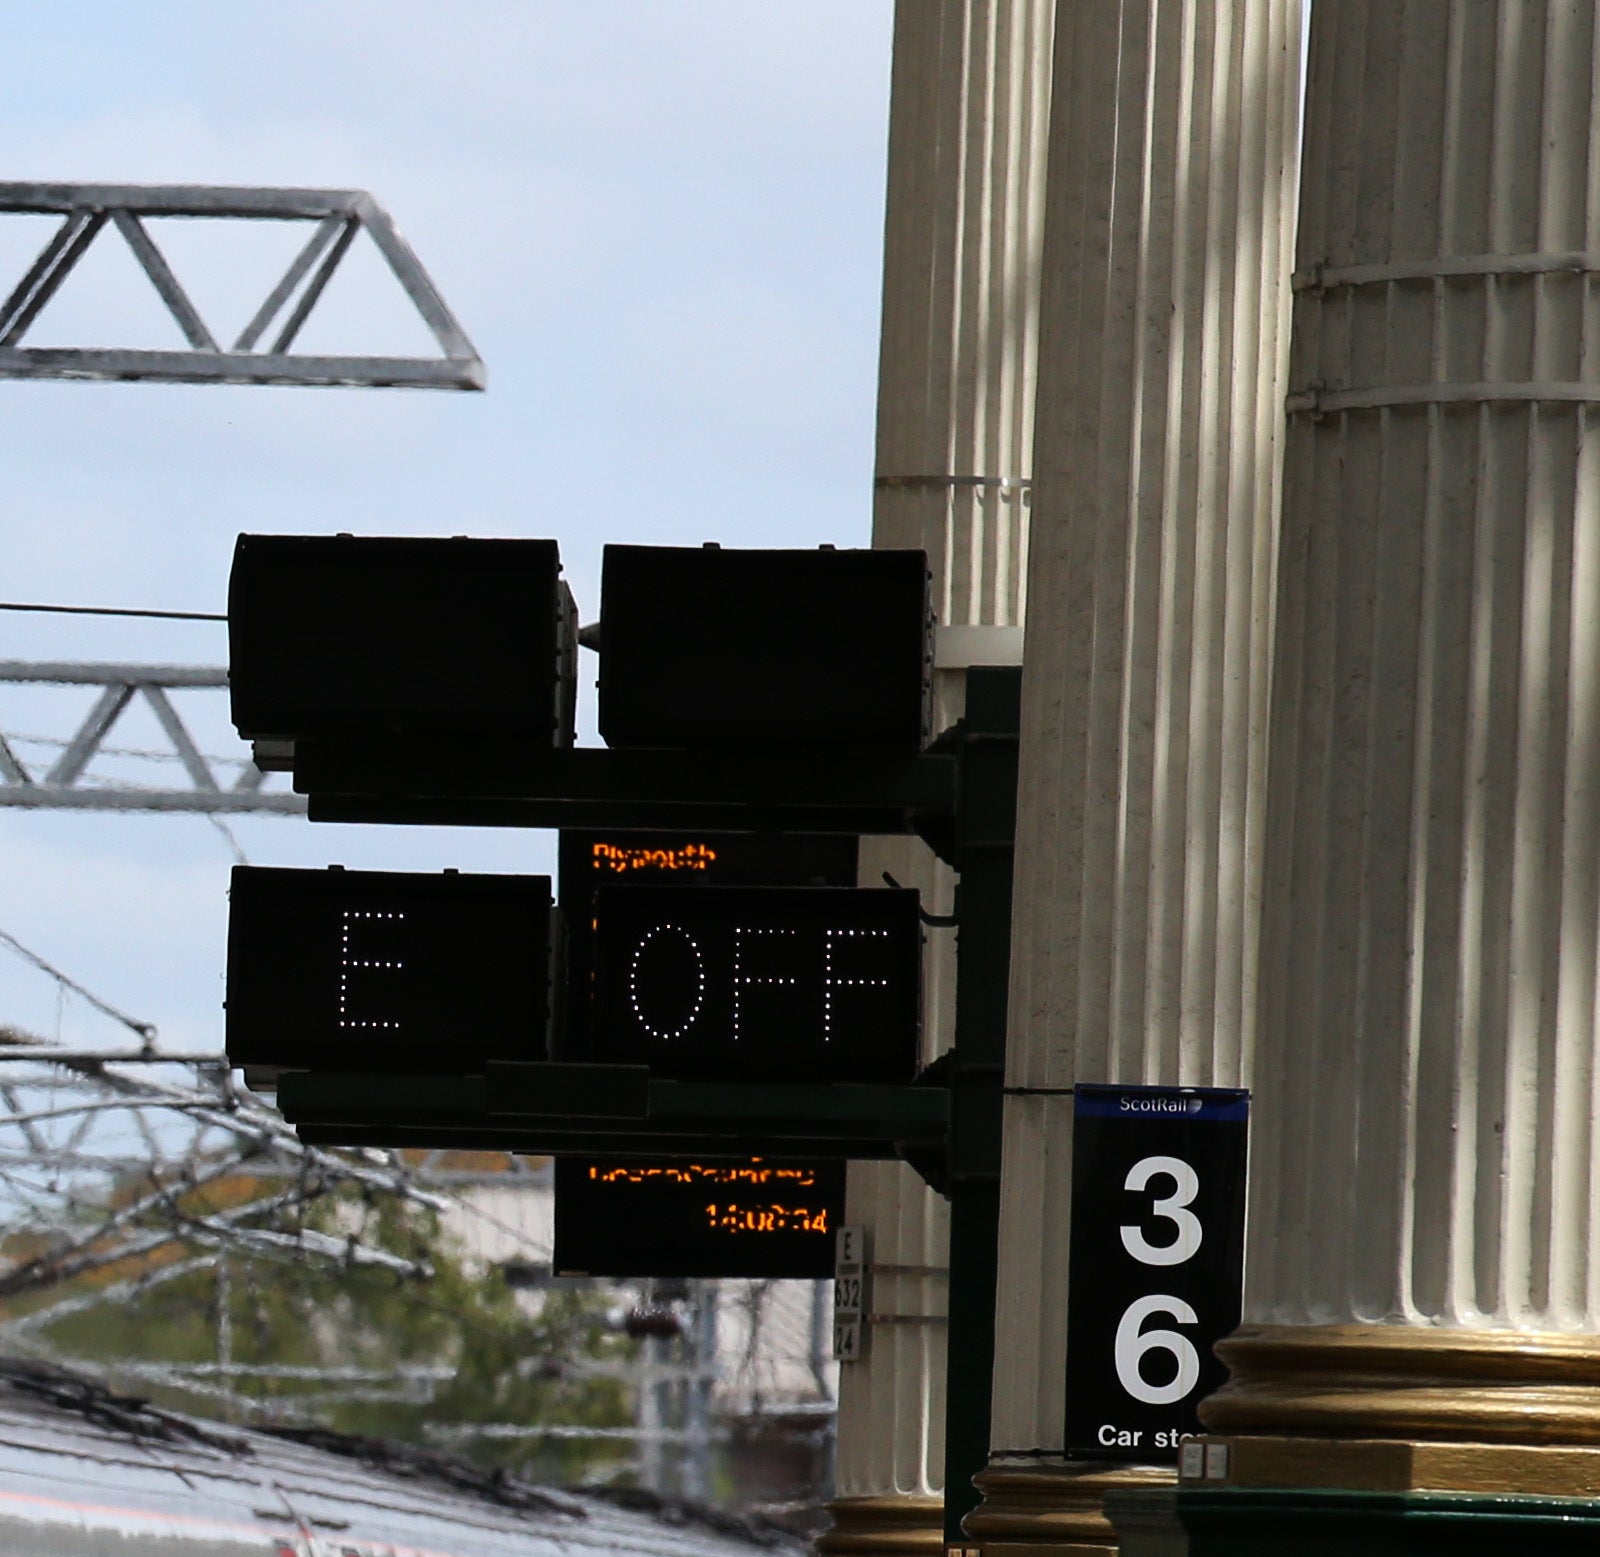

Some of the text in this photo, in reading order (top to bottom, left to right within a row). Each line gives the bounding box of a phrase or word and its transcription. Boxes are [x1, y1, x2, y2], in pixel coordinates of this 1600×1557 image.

[593, 844, 717, 872] Plymouth
[339, 911, 404, 1029] E
[631, 924, 889, 1041] OFF
[1120, 1097, 1187, 1113] ScotRail
[1120, 1156, 1203, 1266] 3
[835, 1279, 860, 1307] 632
[1114, 1294, 1200, 1405] 6
[1098, 1424, 1208, 1448] Car st
